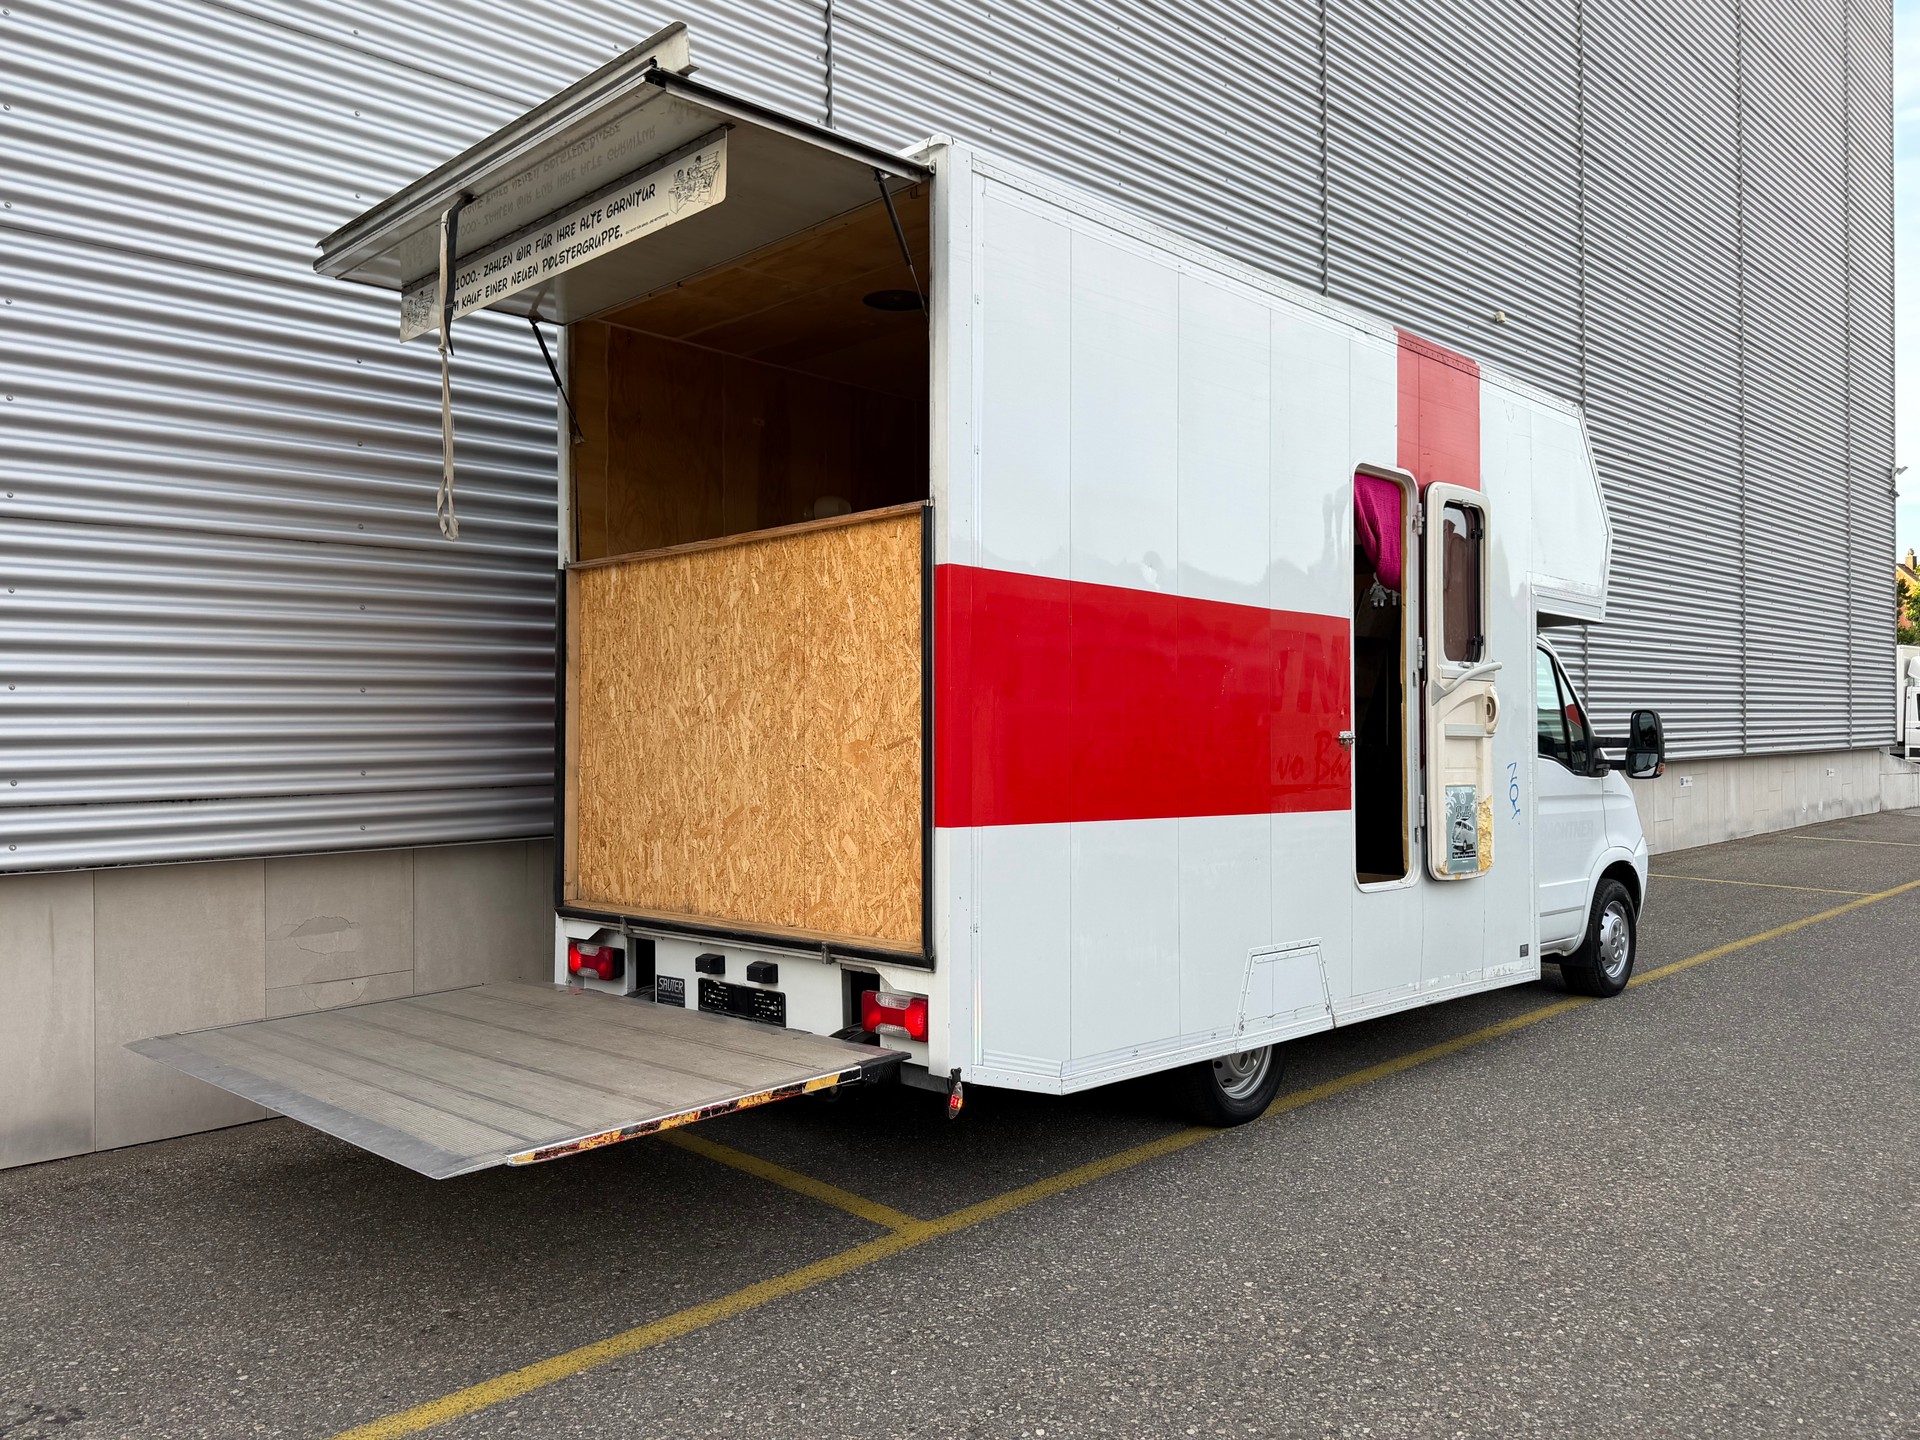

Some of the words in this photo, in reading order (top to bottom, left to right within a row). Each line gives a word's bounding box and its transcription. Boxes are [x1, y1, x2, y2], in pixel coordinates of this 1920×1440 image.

[461, 289, 482, 309] KAUF
[485, 277, 507, 298] EINER
[510, 262, 538, 286] NEUEN
[542, 225, 623, 273] POLSTERGRUPPE.
[483, 252, 513, 277] ZAHLEN
[516, 243, 532, 261] WIR
[535, 233, 553, 253] FÜR
[556, 222, 576, 243] IHRE
[580, 208, 602, 231] ALTE
[606, 183, 656, 219] GARNITUR
[657, 977, 684, 994] SAUTER
